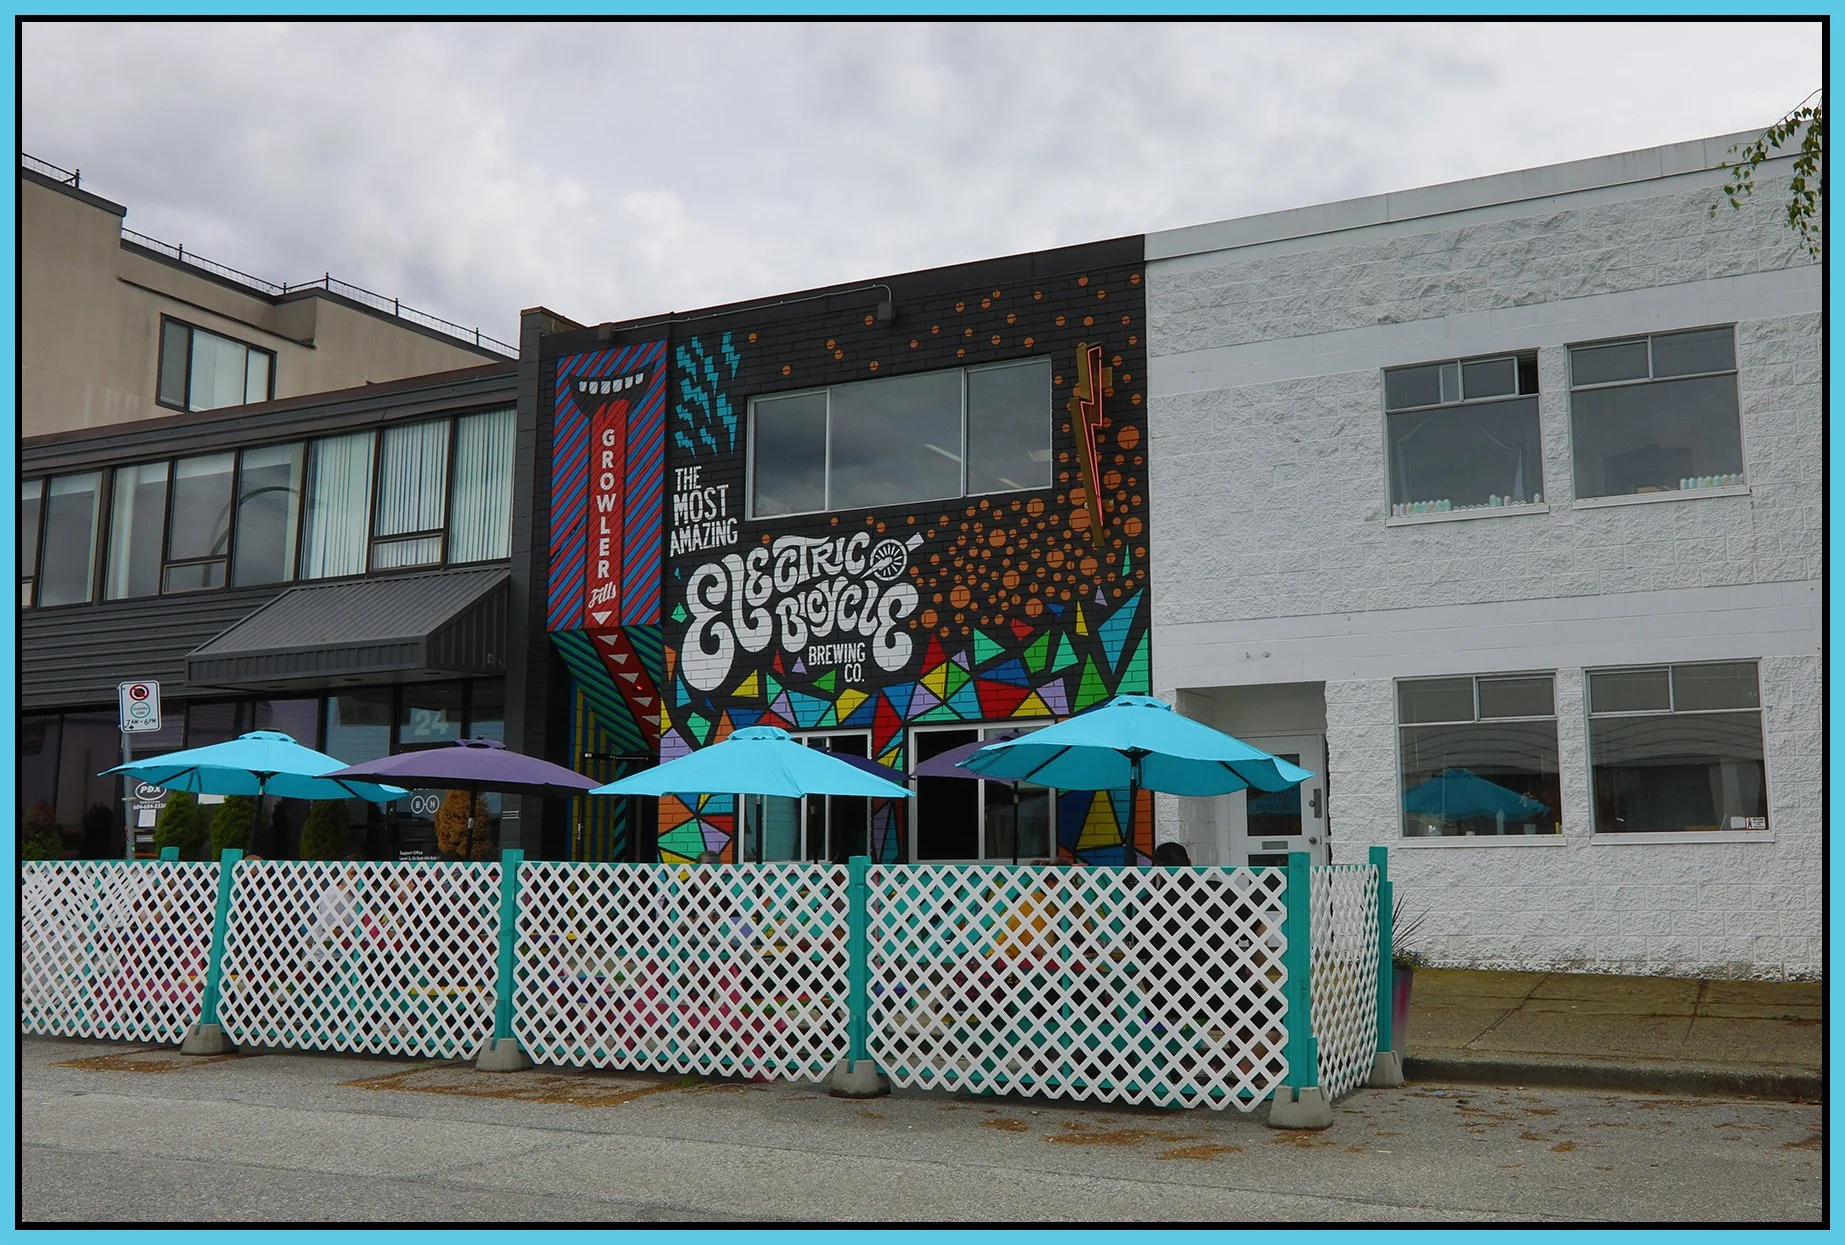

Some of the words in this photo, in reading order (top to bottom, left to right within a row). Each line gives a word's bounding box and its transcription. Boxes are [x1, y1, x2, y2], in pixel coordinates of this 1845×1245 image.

[675, 465, 702, 491] THE
[596, 428, 616, 579] GROWLER
[673, 484, 729, 526] MOST
[669, 517, 738, 557] AMAZING
[588, 581, 617, 608] Fills
[681, 531, 871, 691] ELECTRIC
[776, 576, 919, 672] BICYCLE
[808, 642, 866, 666] BREWING
[844, 663, 865, 683] CO.
[413, 709, 449, 736] 24
[139, 785, 161, 794] PDX
